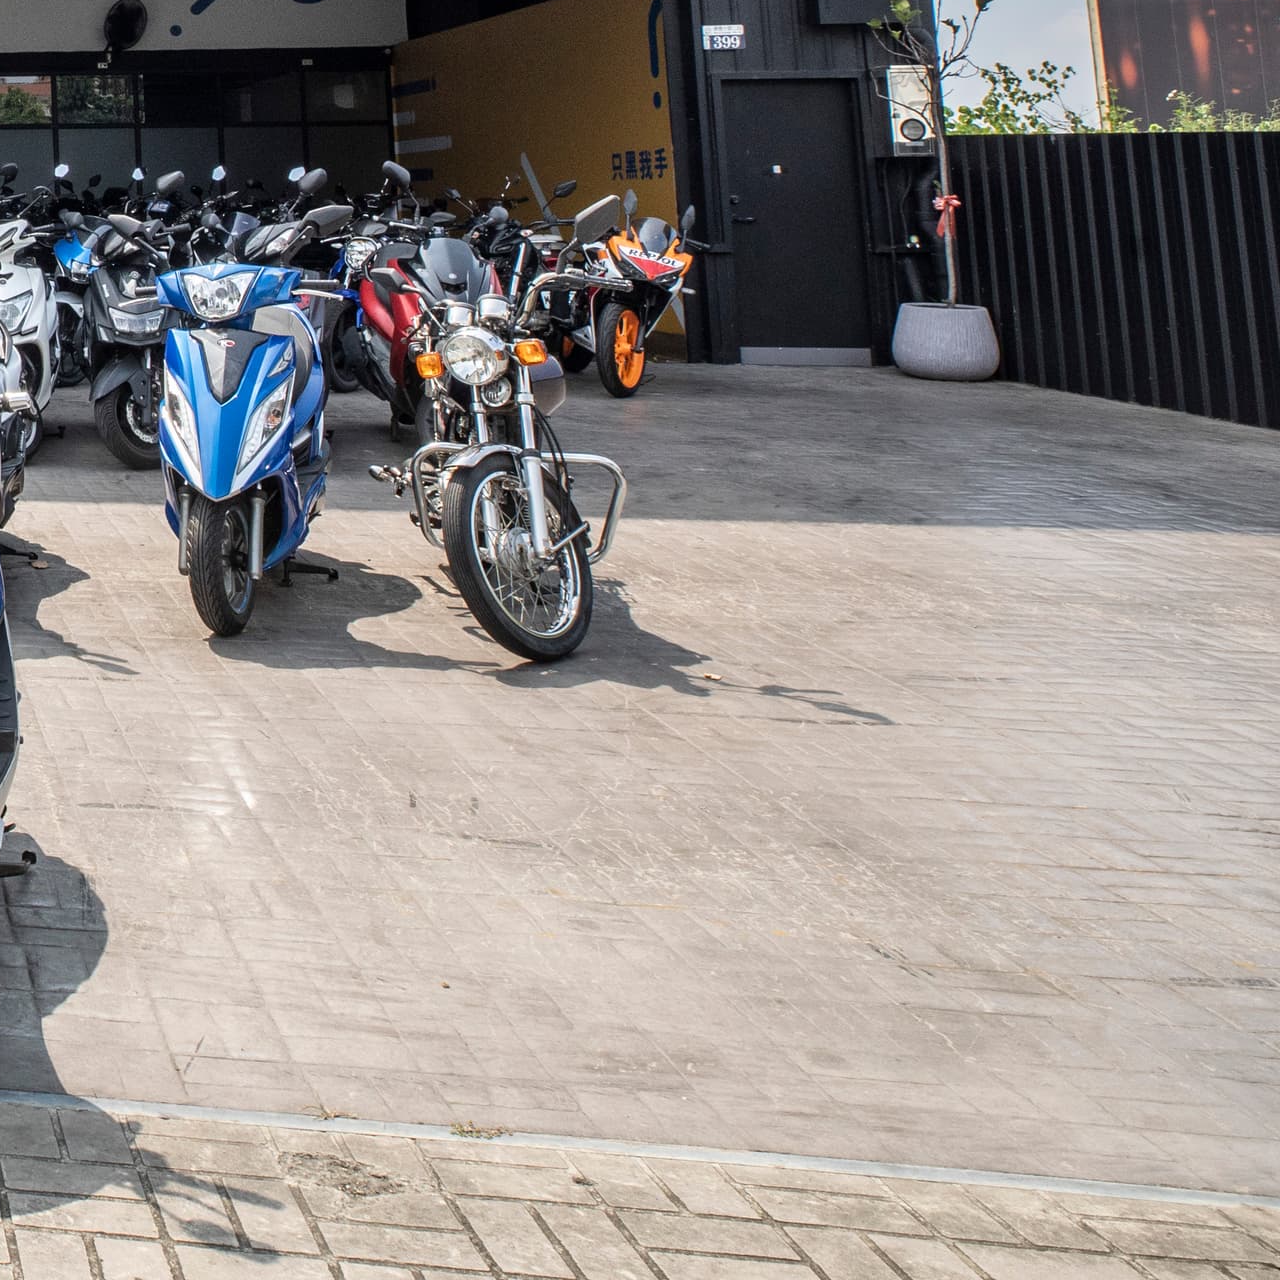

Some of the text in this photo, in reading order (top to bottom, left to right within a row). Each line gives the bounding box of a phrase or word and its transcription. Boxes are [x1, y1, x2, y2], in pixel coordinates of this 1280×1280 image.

[713, 35, 741, 49] 399
[612, 148, 668, 181] 只黑我手
